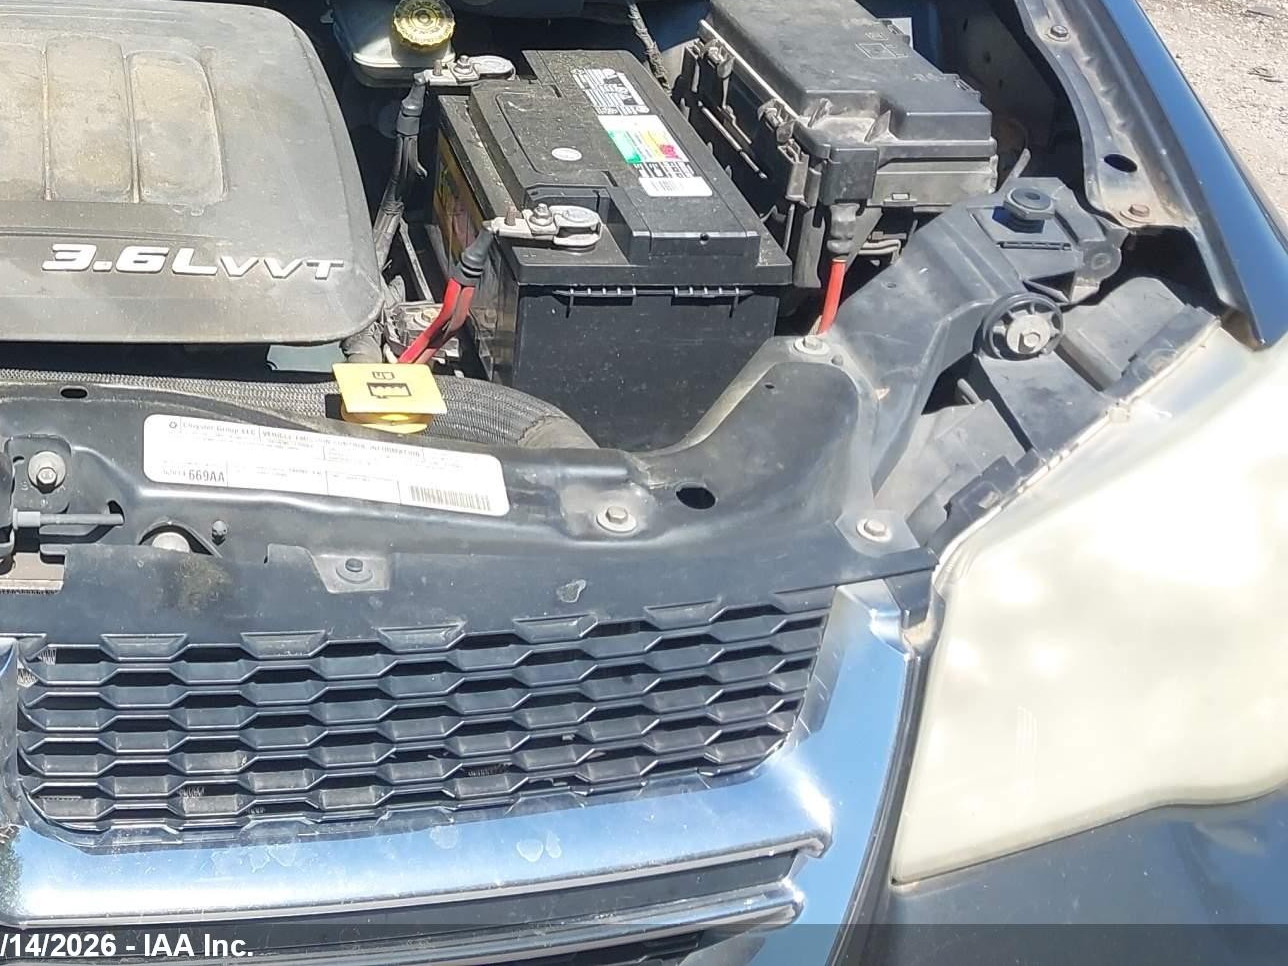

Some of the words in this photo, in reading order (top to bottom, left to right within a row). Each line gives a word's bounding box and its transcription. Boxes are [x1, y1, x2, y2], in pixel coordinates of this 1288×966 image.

[42, 243, 218, 276] 3.6L
[220, 256, 344, 280] VVT
[188, 469, 225, 483] 669AA
